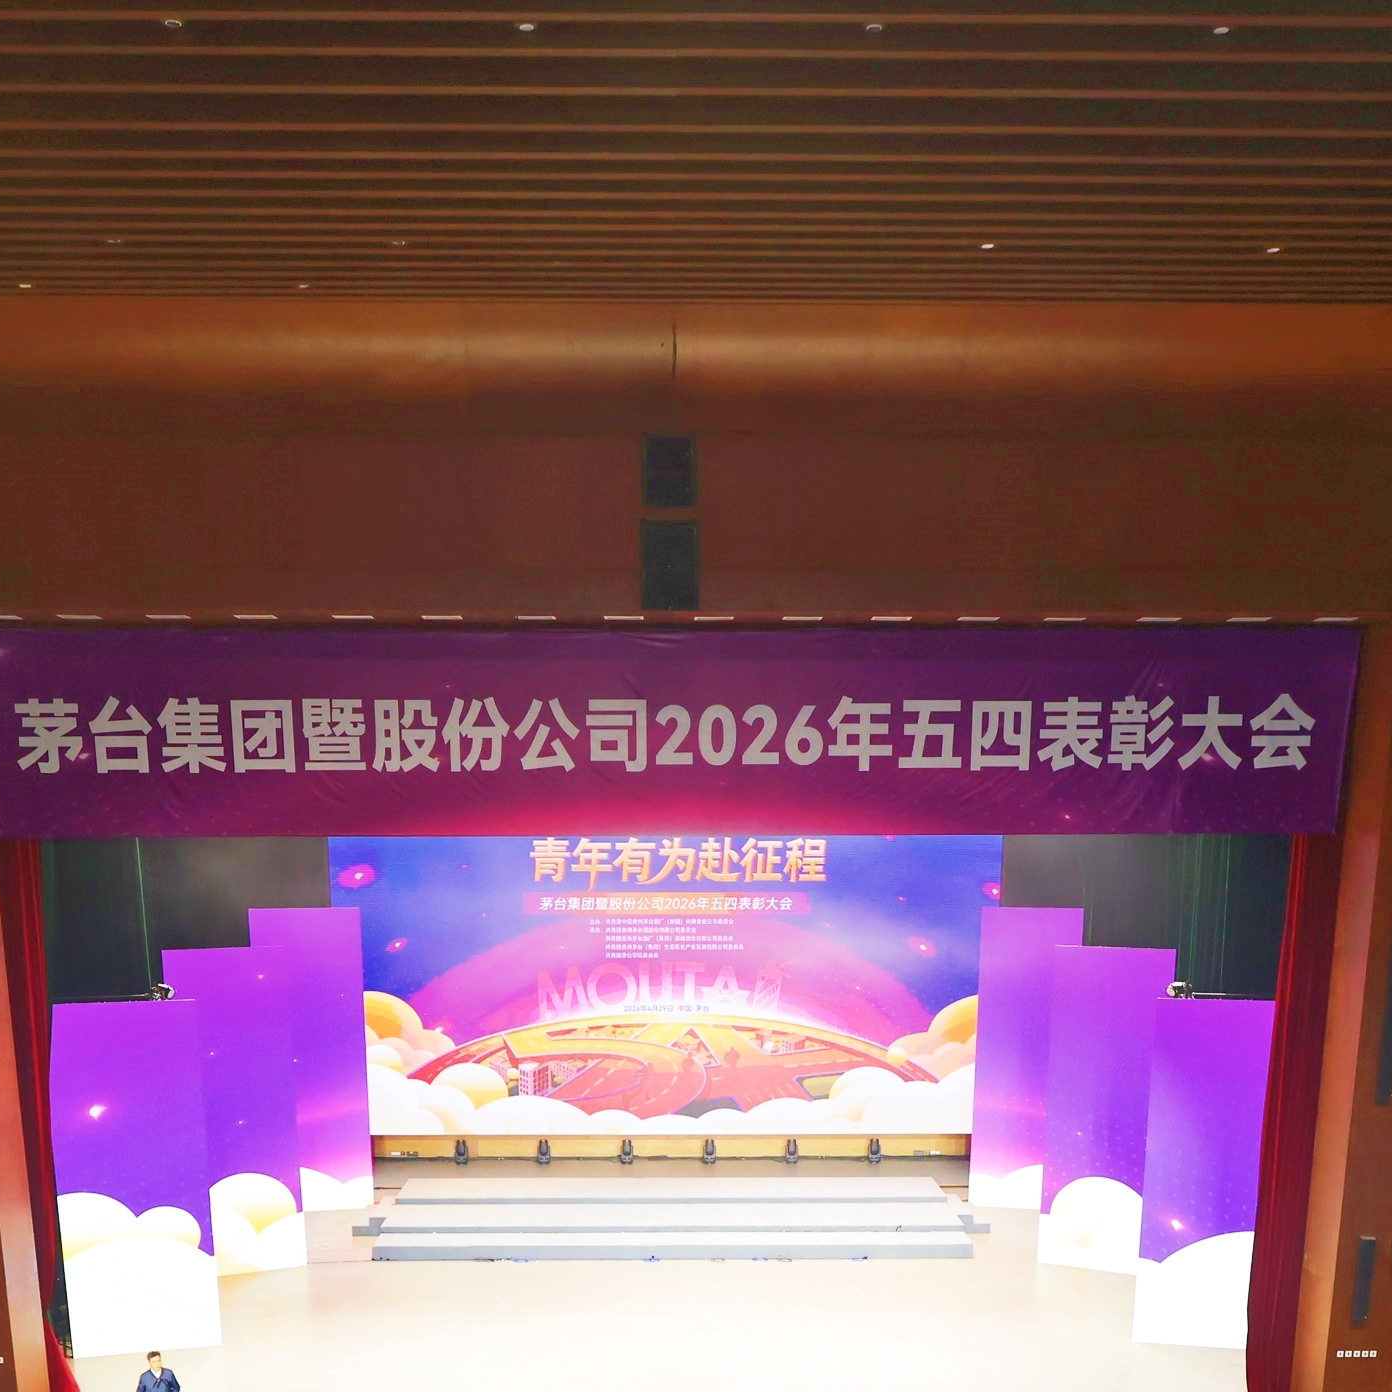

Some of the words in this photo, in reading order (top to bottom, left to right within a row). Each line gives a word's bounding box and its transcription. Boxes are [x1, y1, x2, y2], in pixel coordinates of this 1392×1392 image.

[14, 694, 1316, 773] 茅台集团暨股份公司2026年五四表彰大会
[529, 837, 828, 892] 青年有为赴征程
[539, 897, 793, 911] 茅台集团暨股份公司2026年五四表彰大会
[624, 1004, 674, 1012] 2026年4月29日
